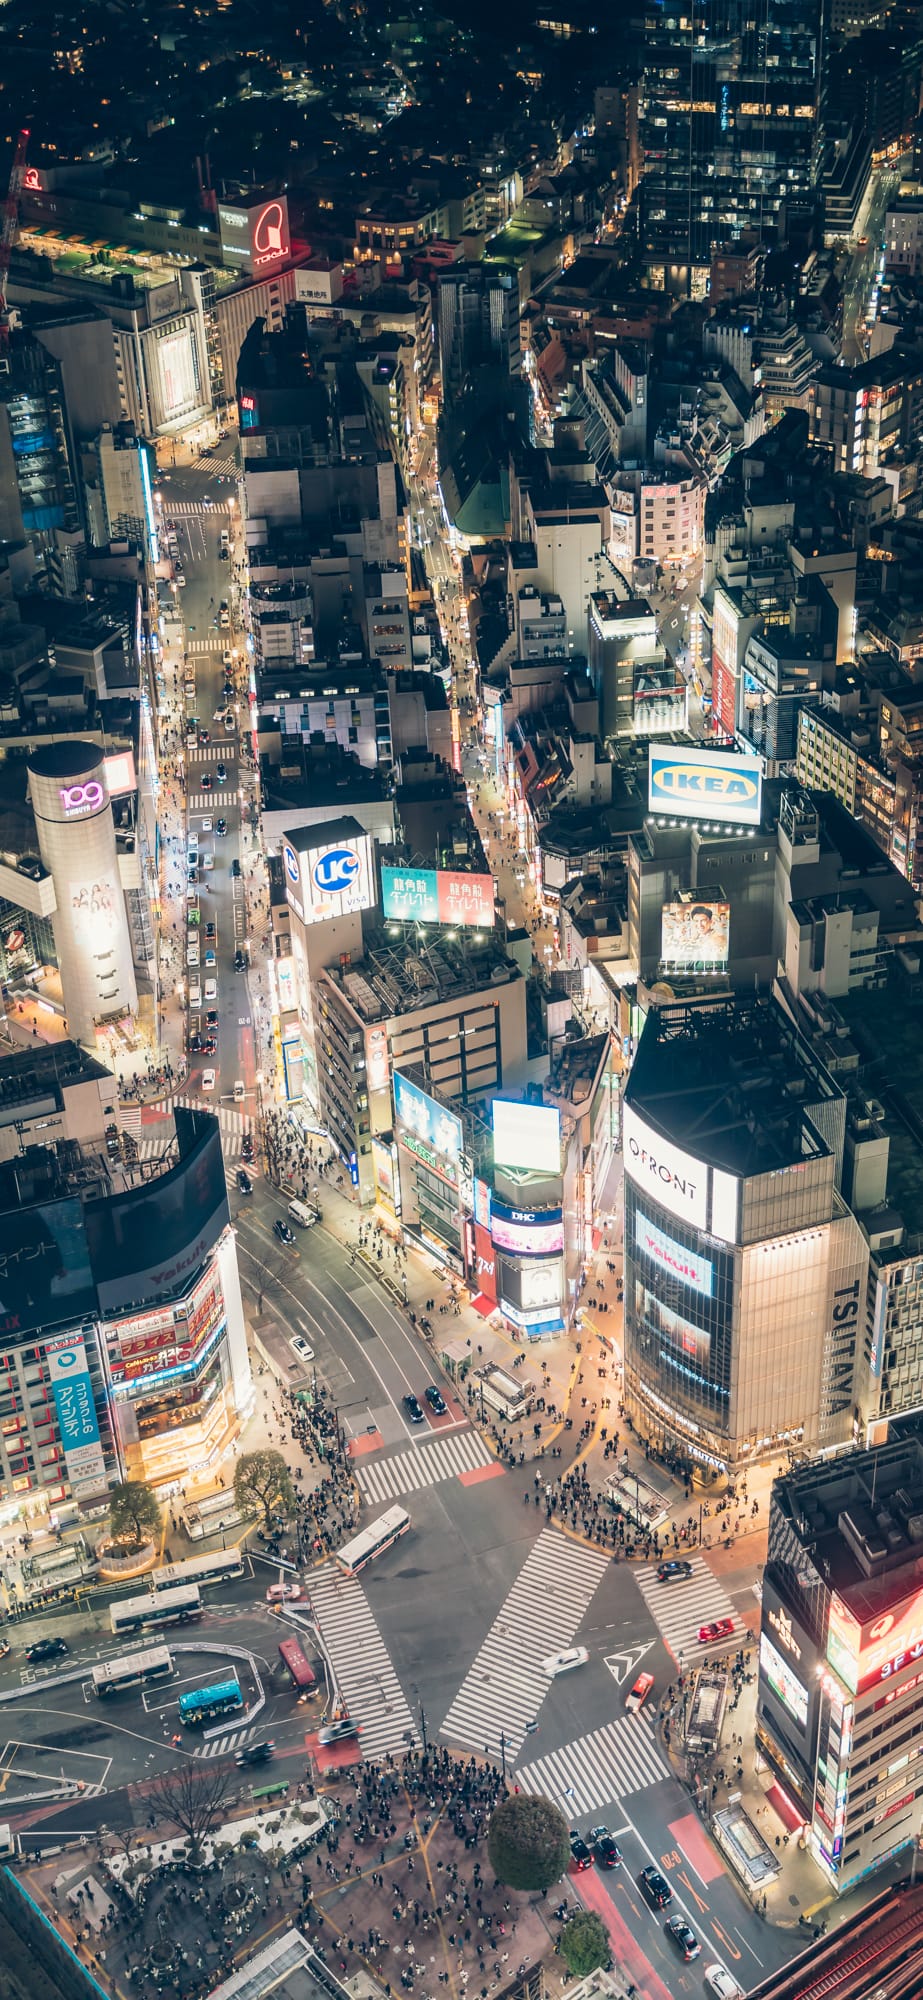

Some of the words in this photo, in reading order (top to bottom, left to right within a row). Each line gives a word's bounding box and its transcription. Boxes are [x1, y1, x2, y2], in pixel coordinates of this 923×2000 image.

[254, 247, 289, 265] TOKYU
[60, 781, 104, 810] 109
[663, 771, 749, 796] IKEA
[317, 856, 358, 884] UC
[347, 895, 367, 906] VISA
[629, 1137, 697, 1199] QFRONT
[512, 1211, 535, 1222] DHC
[150, 1240, 207, 1285] Yakult
[645, 1235, 701, 1282] Yakult
[158, 1347, 184, 1360] ガスト
[826, 1279, 860, 1417] TSUTAYA
[112, 1371, 124, 1381] 7F
[142, 1357, 174, 1373] ガスト
[57, 1385, 80, 1438] アイシティ
[76, 1382, 94, 1434] コンタクトの
[687, 1444, 727, 1472] TSUTAYA
